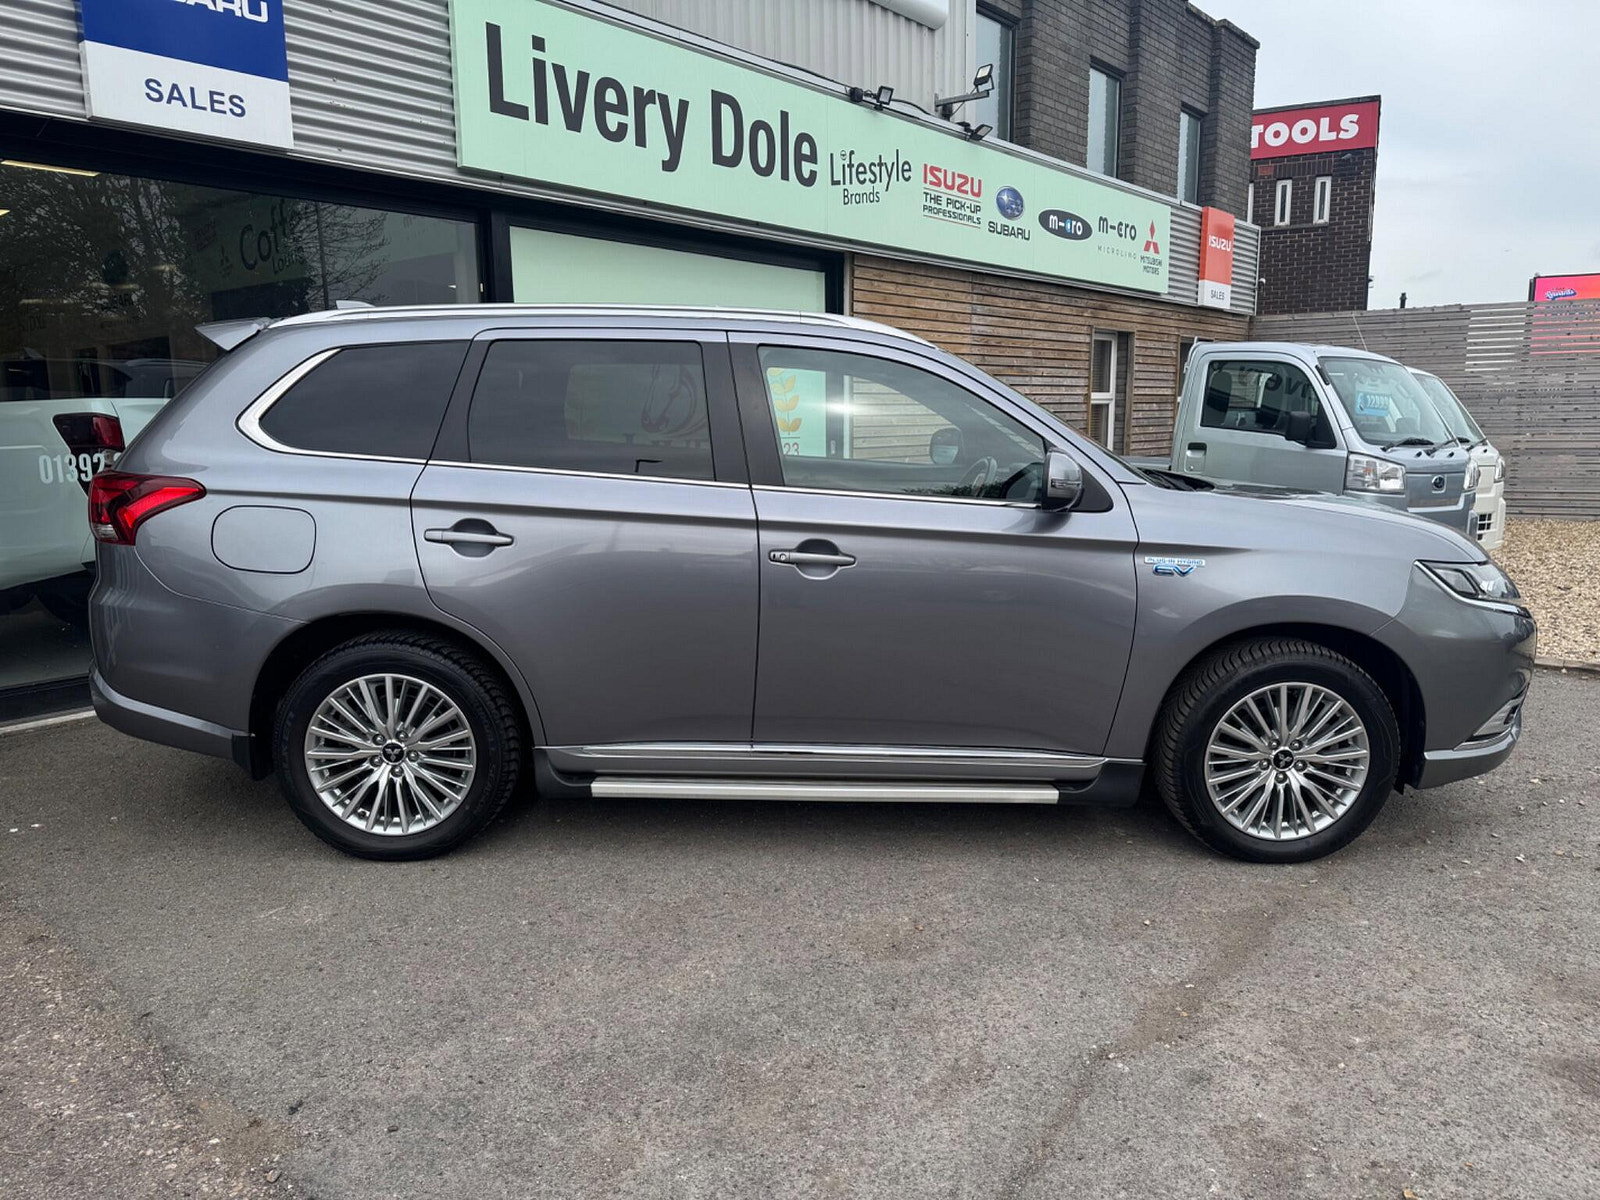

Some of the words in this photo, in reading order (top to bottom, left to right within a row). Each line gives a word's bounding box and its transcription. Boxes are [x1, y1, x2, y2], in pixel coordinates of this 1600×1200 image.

[144, 77, 247, 119] SALES
[485, 21, 690, 173] Livery
[710, 89, 818, 188] Dole
[1250, 113, 1360, 149] TOOLS
[829, 149, 912, 192] Lifestyle
[923, 163, 982, 198] ISUZU
[842, 186, 881, 205] Brands
[923, 191, 943, 208] THE
[946, 197, 982, 214] PICK-UP
[922, 204, 982, 225] PROFESSIONALS
[987, 220, 1031, 241] SUBARU
[1208, 234, 1232, 252] ISUZU
[1210, 288, 1225, 301] SALES
[38, 453, 105, 484] 01392
[1153, 563, 1196, 577] EV
